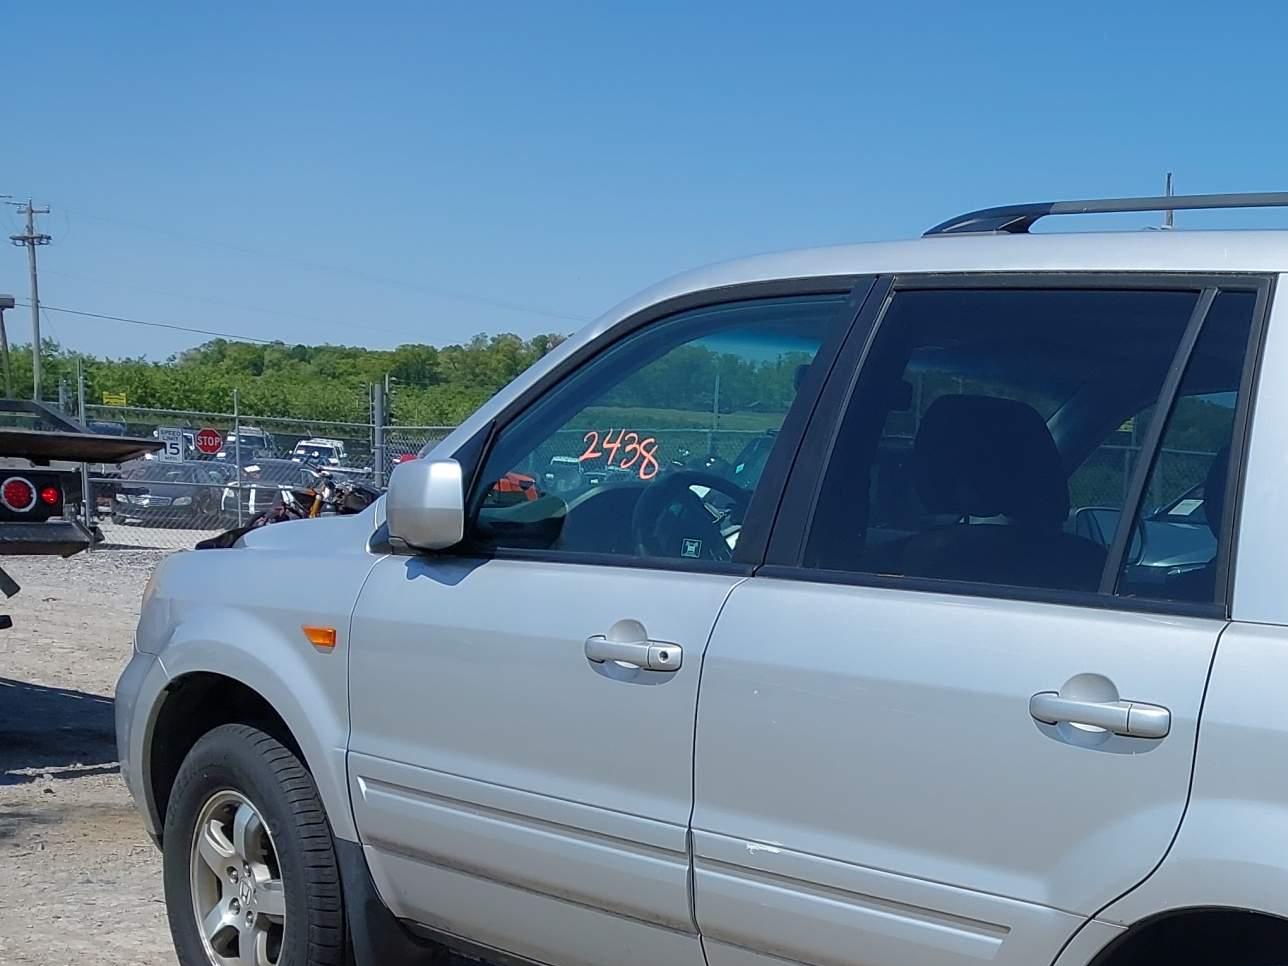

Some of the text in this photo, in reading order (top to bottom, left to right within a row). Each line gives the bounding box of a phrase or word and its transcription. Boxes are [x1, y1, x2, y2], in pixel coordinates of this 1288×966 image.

[197, 436, 222, 447] STOP
[162, 442, 180, 456] 15
[579, 428, 659, 480] 2438
